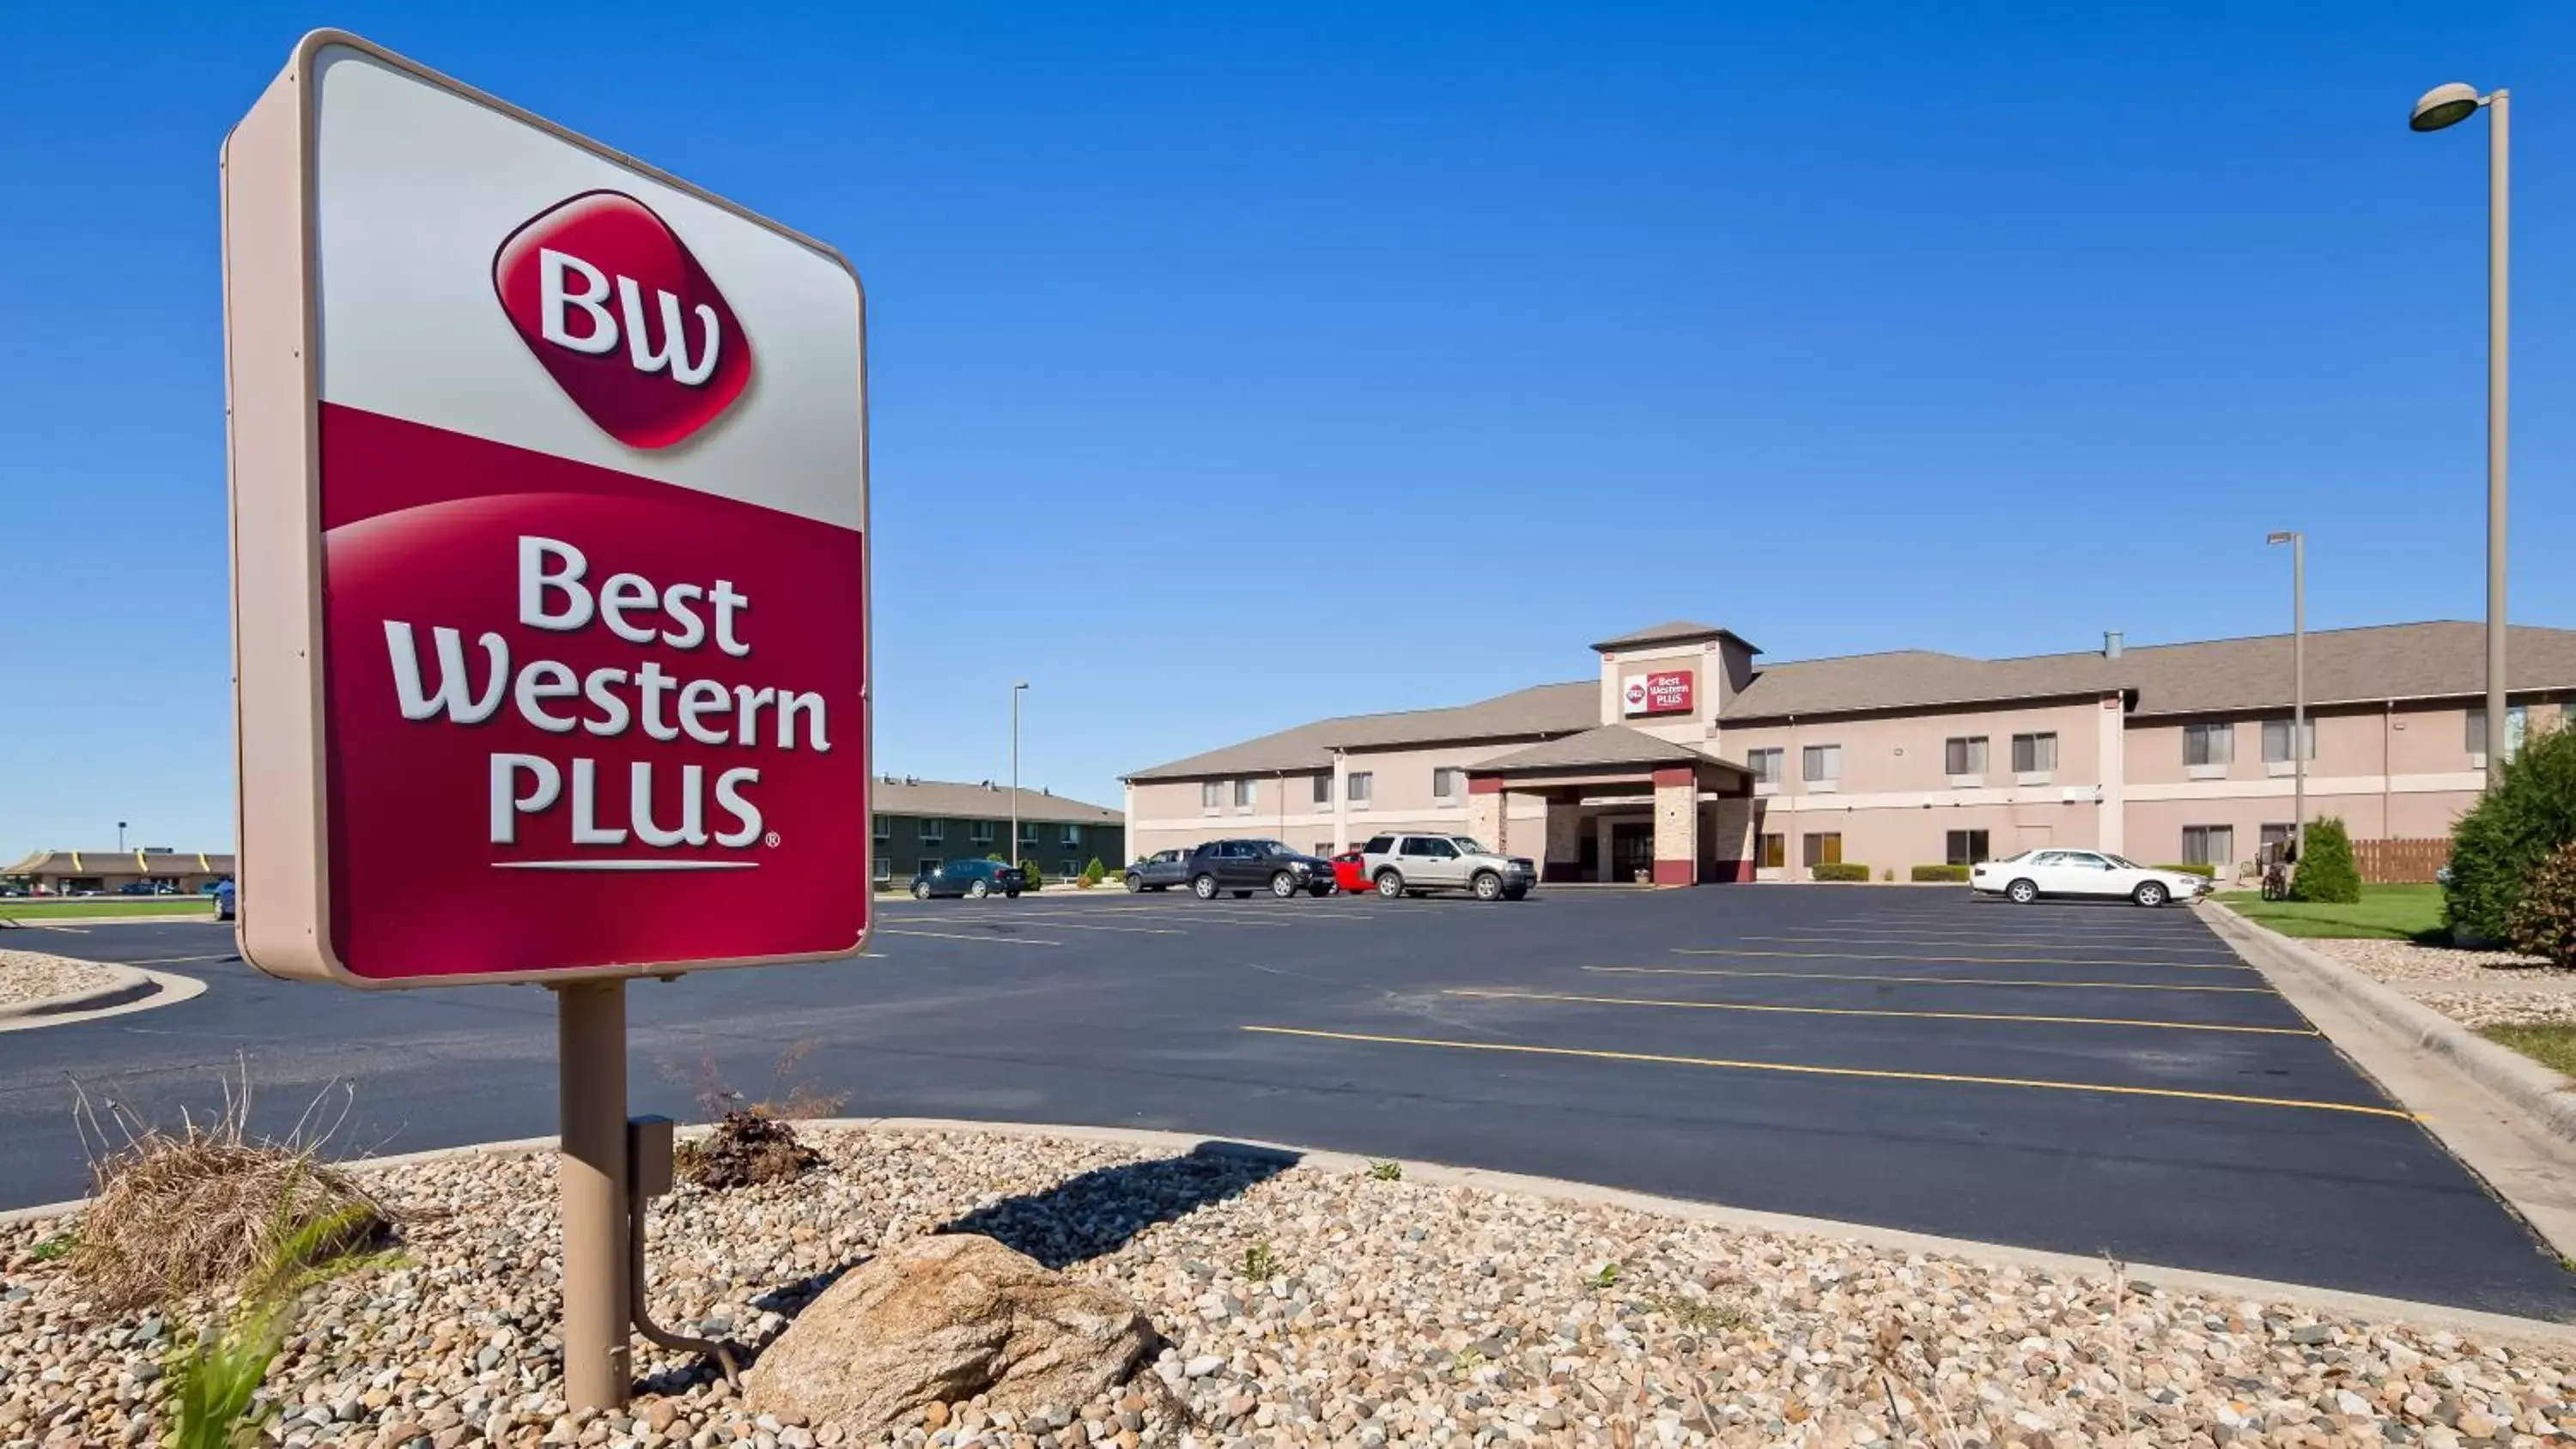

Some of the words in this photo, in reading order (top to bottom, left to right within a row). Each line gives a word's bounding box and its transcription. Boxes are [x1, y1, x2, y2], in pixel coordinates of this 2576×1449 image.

[540, 247, 720, 386] BW
[519, 536, 750, 657] Best
[384, 620, 831, 753] Western
